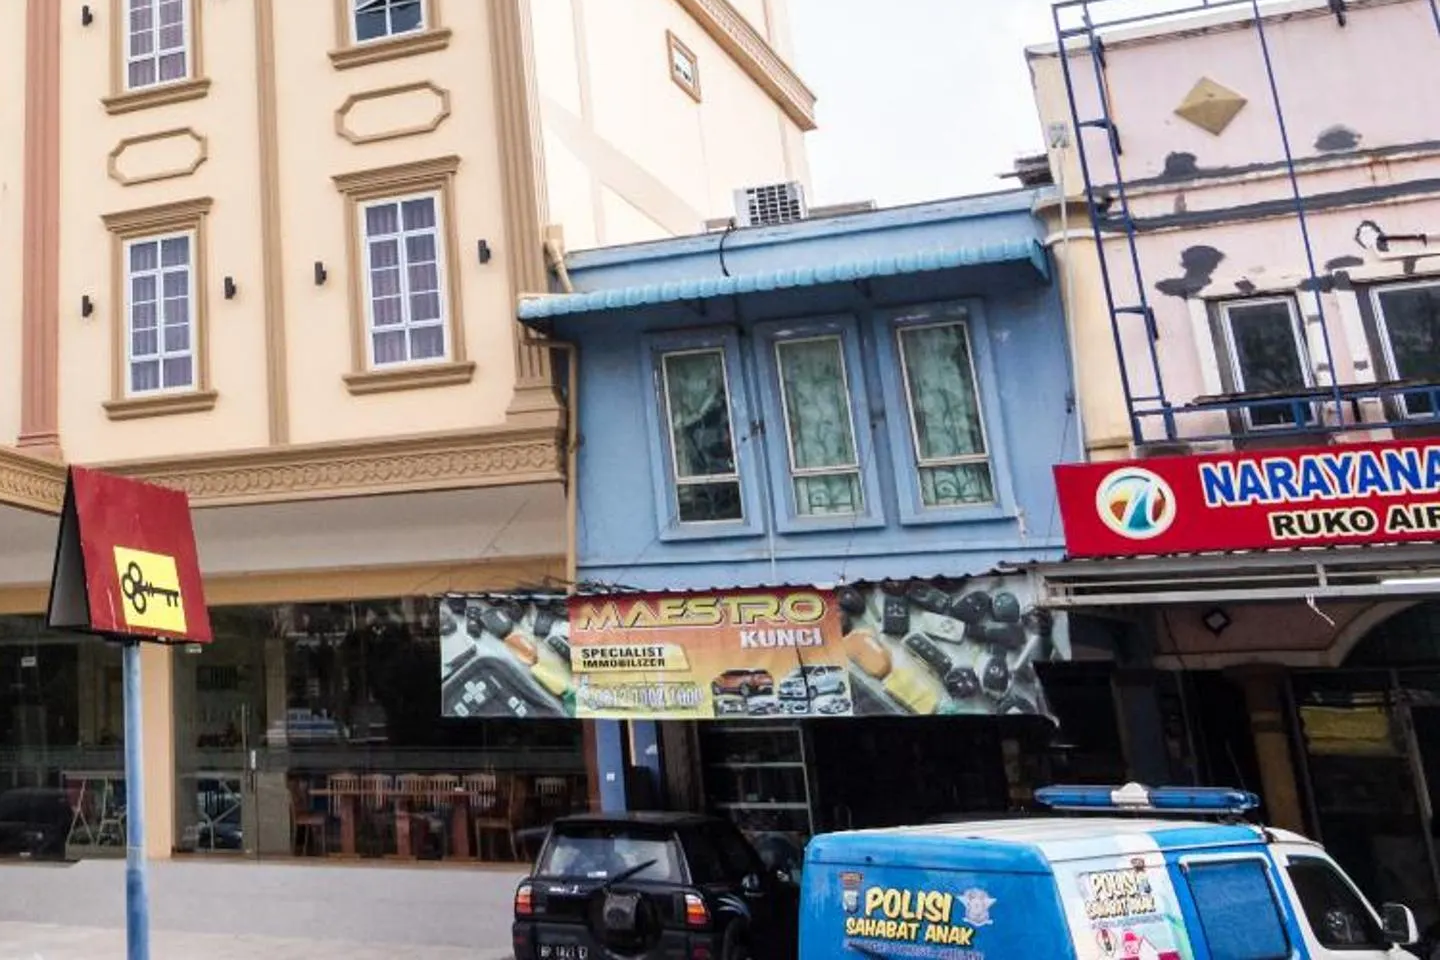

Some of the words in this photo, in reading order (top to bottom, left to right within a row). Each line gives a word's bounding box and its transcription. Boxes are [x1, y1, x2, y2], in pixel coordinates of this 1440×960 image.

[1271, 508, 1377, 538] RUKO
[578, 591, 826, 632] MAESTRO
[581, 646, 665, 659] SPECIALIST
[740, 627, 824, 649] KUNCI
[582, 658, 666, 669] IMMOBILIZER
[865, 886, 953, 923] POLISI
[845, 916, 920, 941] SAHABAT
[924, 923, 975, 946] ANAK
